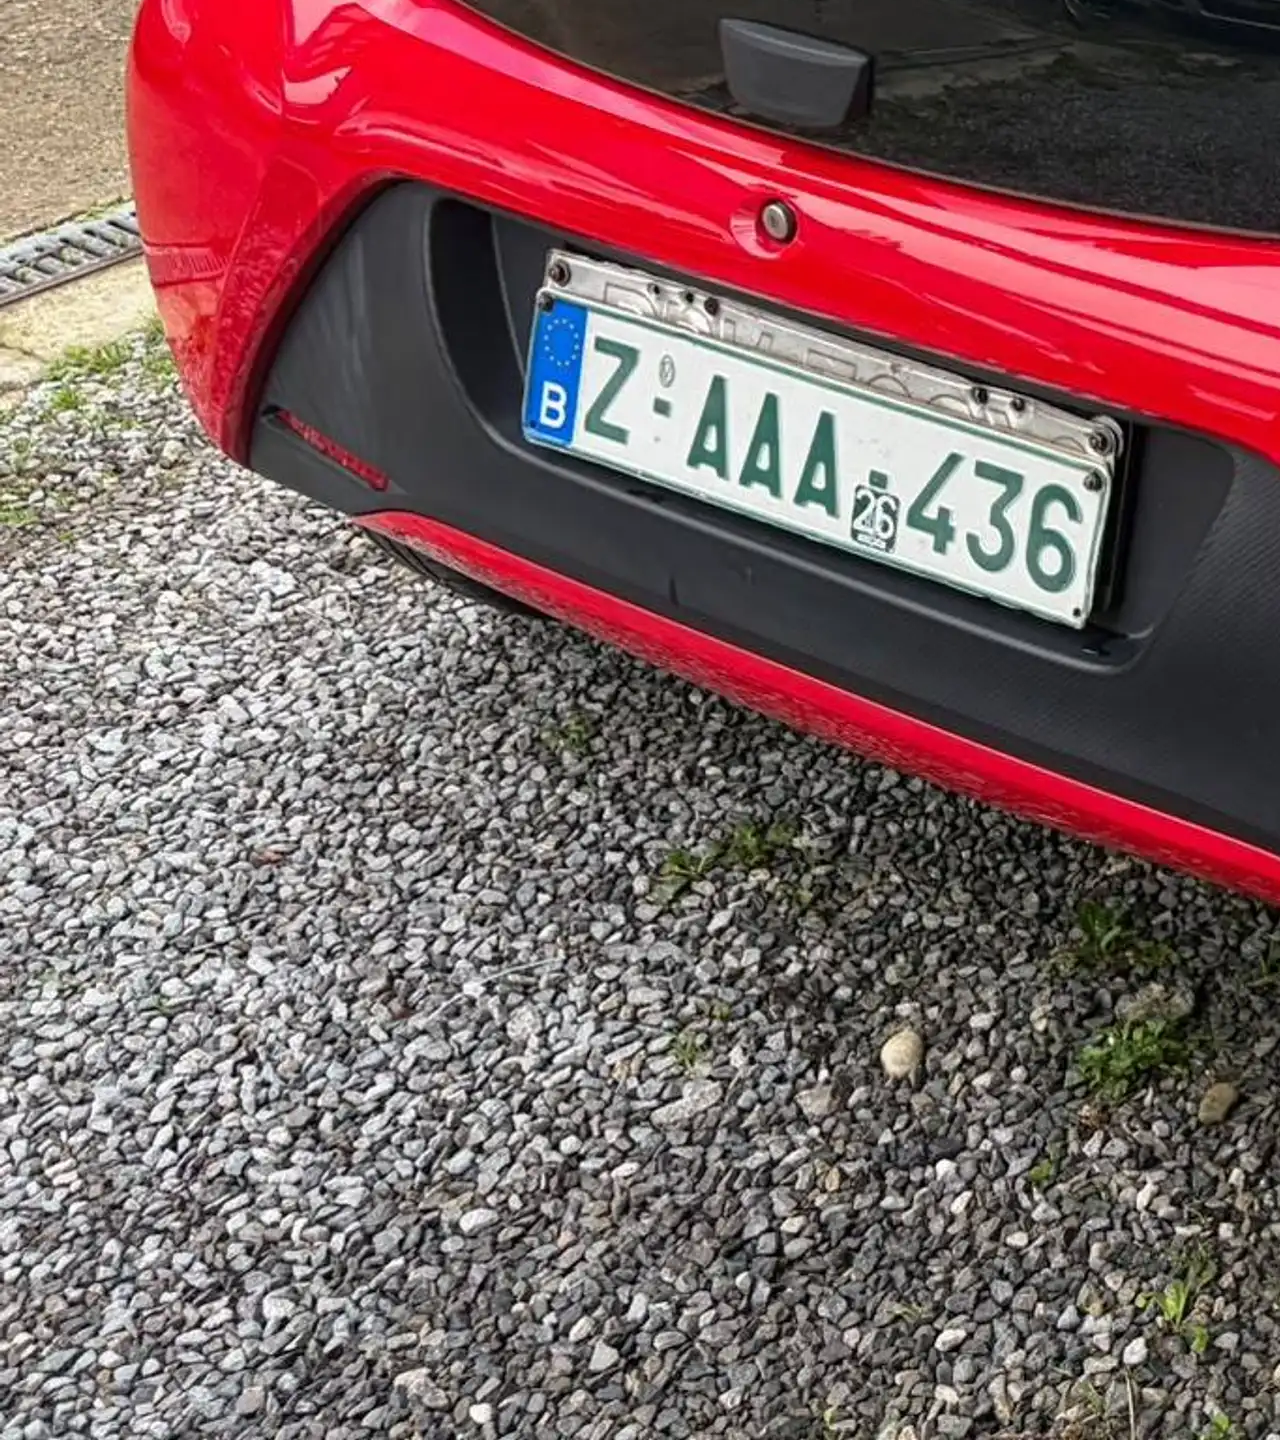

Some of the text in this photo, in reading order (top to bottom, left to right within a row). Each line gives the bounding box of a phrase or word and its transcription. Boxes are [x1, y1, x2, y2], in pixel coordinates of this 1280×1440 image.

[539, 380, 568, 429] B
[584, 336, 1083, 594] Z-AAA-436
[852, 488, 895, 540] 26
